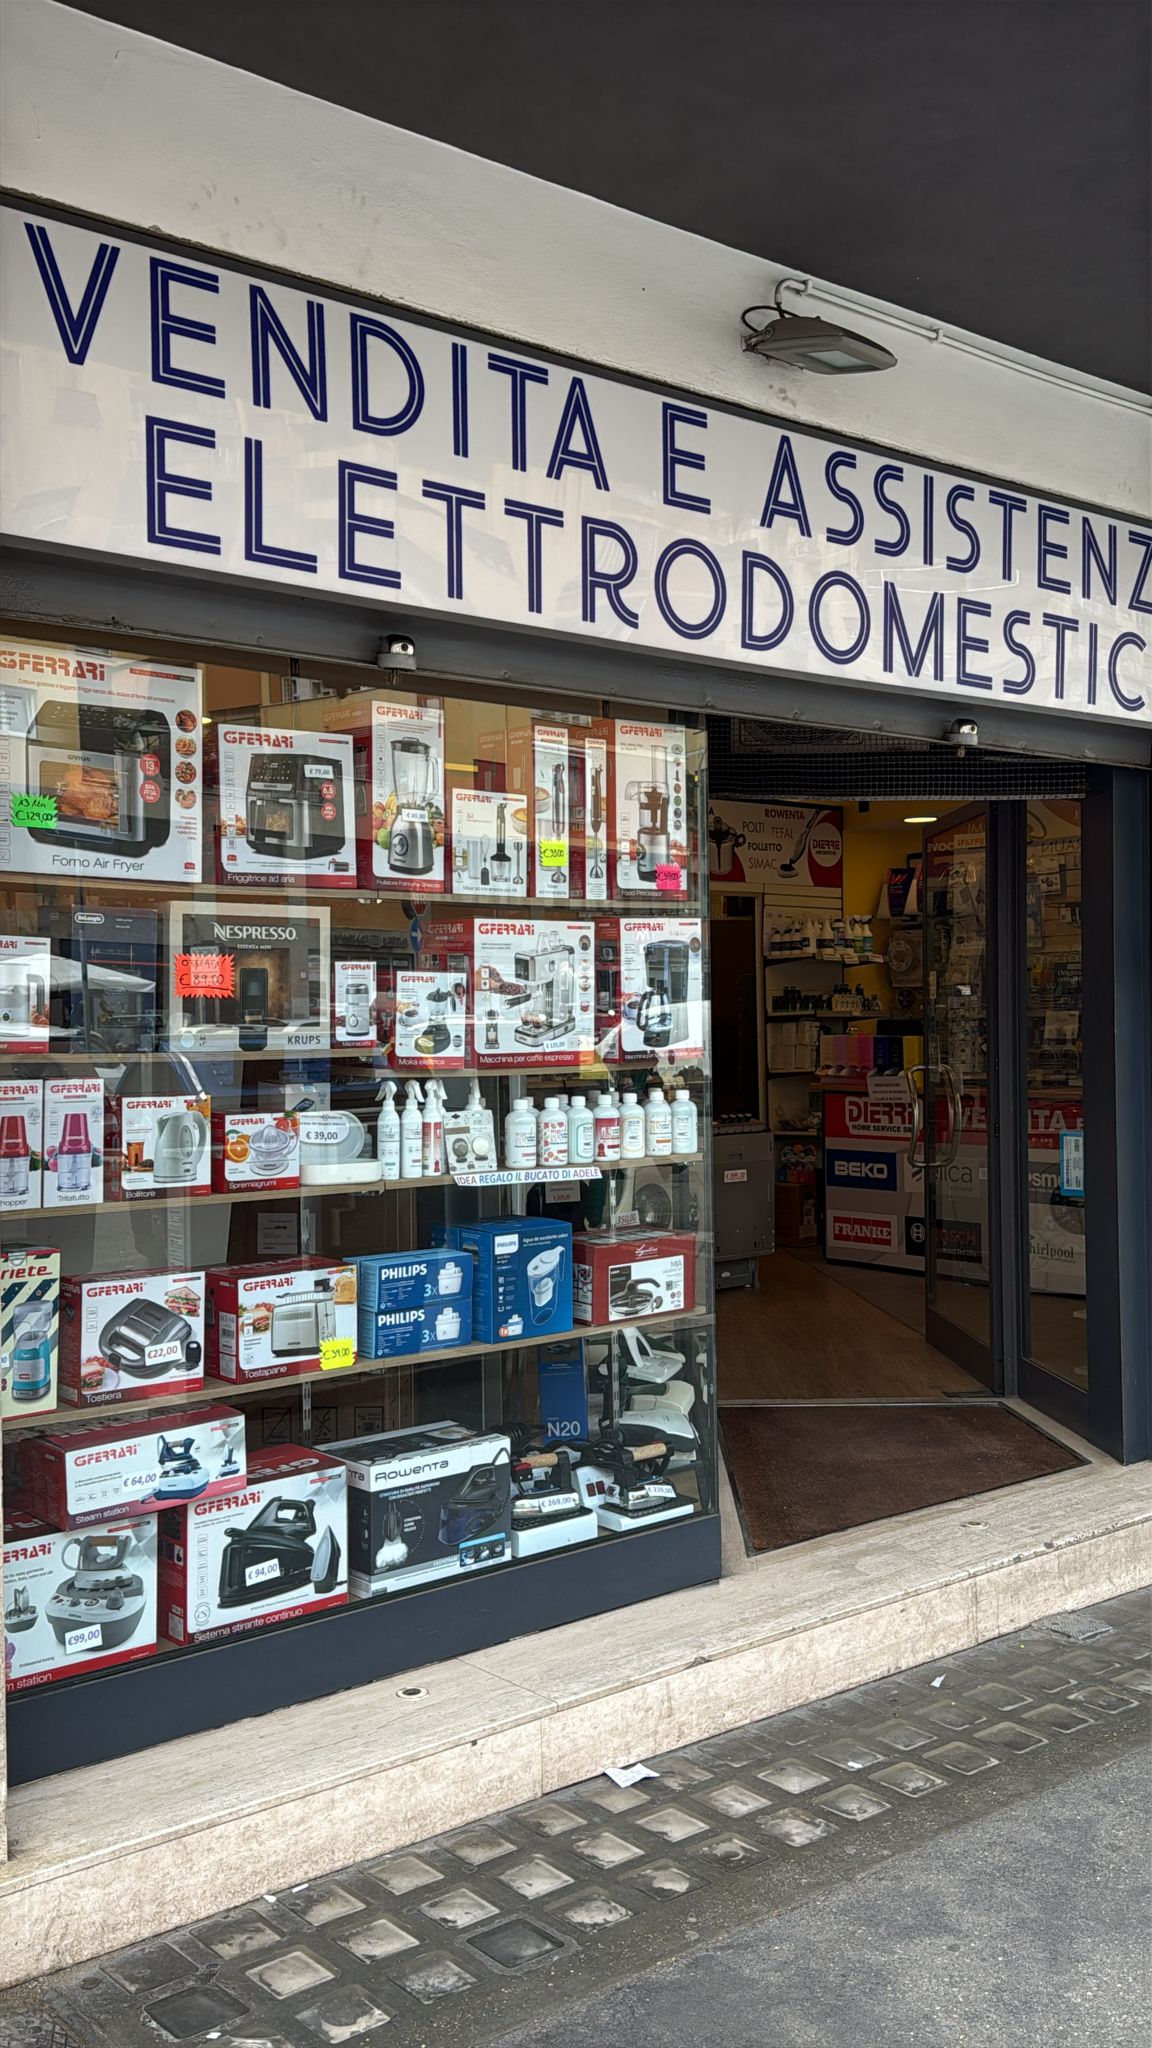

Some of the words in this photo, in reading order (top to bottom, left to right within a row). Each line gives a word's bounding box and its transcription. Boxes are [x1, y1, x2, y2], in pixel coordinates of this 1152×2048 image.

[24, 222, 610, 492] VENDITA
[662, 401, 711, 514] E
[760, 435, 1152, 614] ASSISTENZ
[146, 415, 1147, 713] ELETTRODOMESTIC
[764, 808, 806, 820] ROWENTA
[742, 821, 766, 834] POLTI
[771, 827, 794, 840] TEFAL
[748, 842, 783, 852] FOLLETTO
[812, 839, 841, 851] DIERRE
[52, 854, 90, 869] Forno
[93, 857, 109, 870] Air
[113, 859, 144, 872] Fryer
[749, 857, 777, 870] SIMAC
[227, 874, 267, 884] Friggitrice
[268, 875, 279, 883] ad
[280, 876, 295, 884] aria
[622, 889, 636, 897] Food
[210, 922, 297, 941] NESPRESSO
[288, 1035, 321, 1045] KRUPS
[480, 1055, 513, 1063] Macchina
[514, 1056, 526, 1064] per
[526, 1054, 543, 1062] caffè
[544, 1054, 574, 1062] espresso
[852, 1123, 871, 1132] HOME
[872, 1125, 901, 1133] SERVICE
[306, 1132, 311, 1140] €
[314, 1131, 338, 1141] 39,00
[834, 1160, 888, 1179] BEKO
[456, 1176, 477, 1185] IDEA
[479, 1173, 513, 1184] REGALO
[515, 1173, 522, 1182] IL
[524, 1170, 559, 1182] BUCATO
[562, 1170, 571, 1179] DI
[573, 1168, 600, 1178] ADELE
[229, 1179, 277, 1190] Spremiagrumi
[58, 1193, 90, 1203] Tritatutto
[125, 1190, 156, 1199] Bollitore
[833, 1223, 891, 1240] FRANKE
[381, 1263, 428, 1281] PHILIPS
[424, 1284, 438, 1297] 3x
[378, 1309, 425, 1327] PHILIPS
[421, 1330, 436, 1344] 3x
[244, 1365, 288, 1379] Tostapane
[86, 1391, 122, 1403] Tostiera
[548, 1420, 581, 1437] N20
[123, 1478, 129, 1487] €
[131, 1474, 156, 1487] 64,00
[75, 1511, 102, 1525] Steam
[103, 1505, 129, 1520] station
[248, 1571, 254, 1580] €
[255, 1563, 278, 1578] 94,00
[194, 1626, 230, 1643] Sistema
[231, 1615, 264, 1635] stirante
[266, 1608, 303, 1625] continuo
[17, 1672, 52, 1689] station
